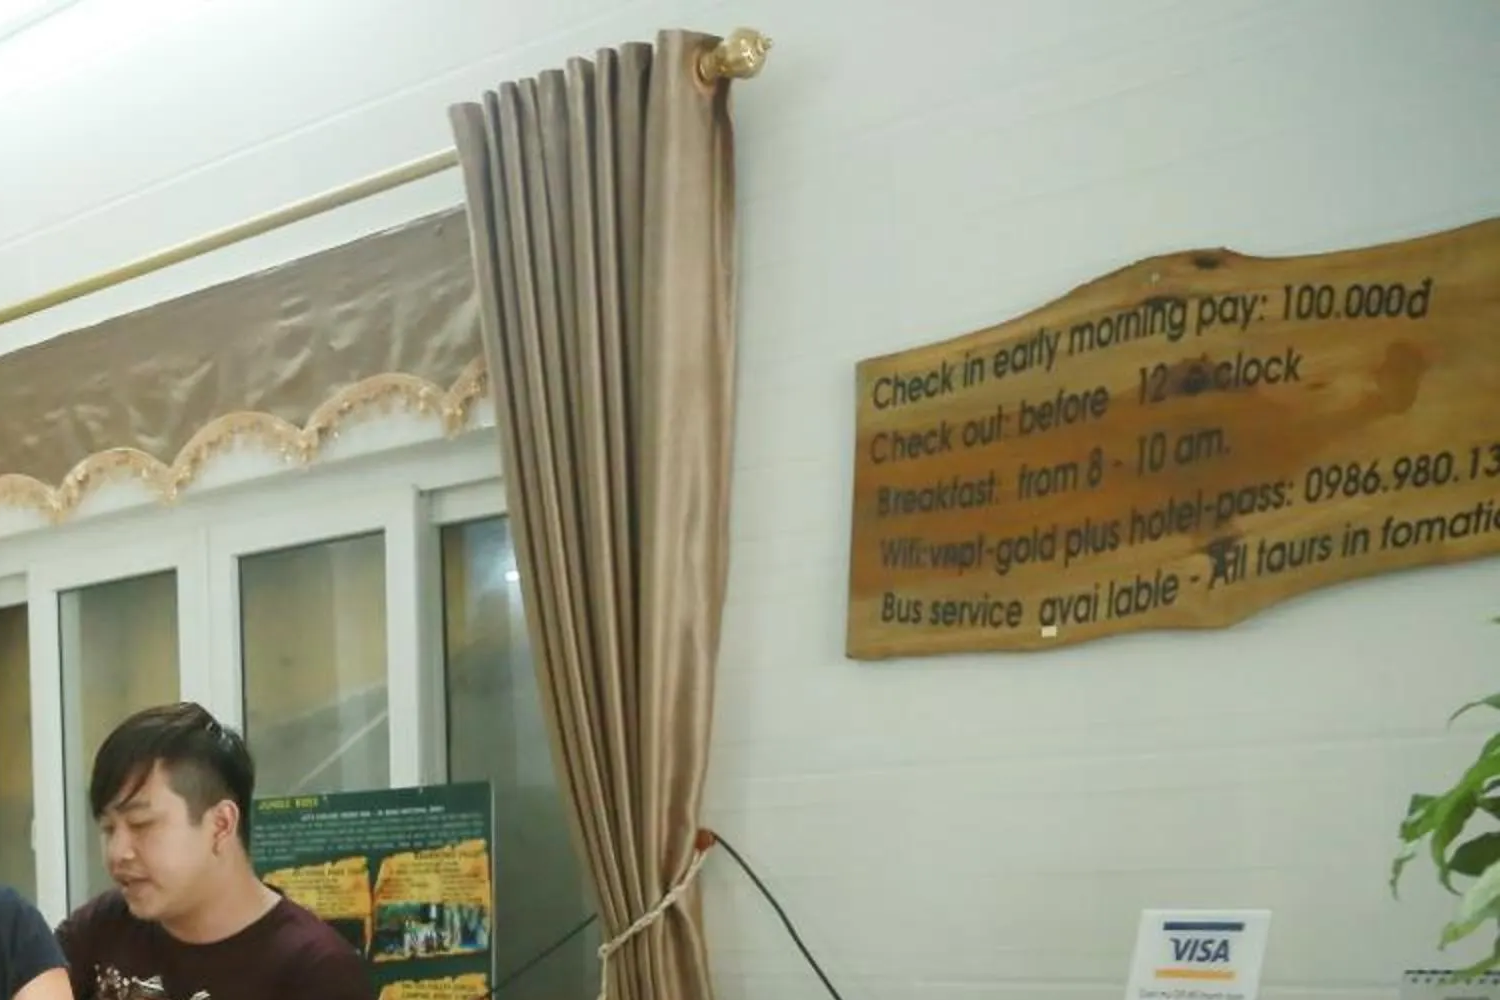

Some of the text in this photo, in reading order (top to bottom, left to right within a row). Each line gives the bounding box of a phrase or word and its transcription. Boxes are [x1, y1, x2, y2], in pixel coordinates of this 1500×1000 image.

[872, 276, 1433, 410] Check in early morning pay: 100.000đ
[870, 421, 952, 464] Check
[1018, 385, 1110, 435] before
[1139, 363, 1170, 405] 12
[1018, 462, 1079, 501] from
[1086, 446, 1104, 489] 8
[1137, 430, 1167, 477] 10
[1174, 427, 1231, 466] am.
[881, 592, 923, 623] Bus
[929, 593, 1024, 628] service
[1256, 532, 1332, 576] tours
[1063, 515, 1121, 569] plus
[1169, 938, 1232, 963] VISA
